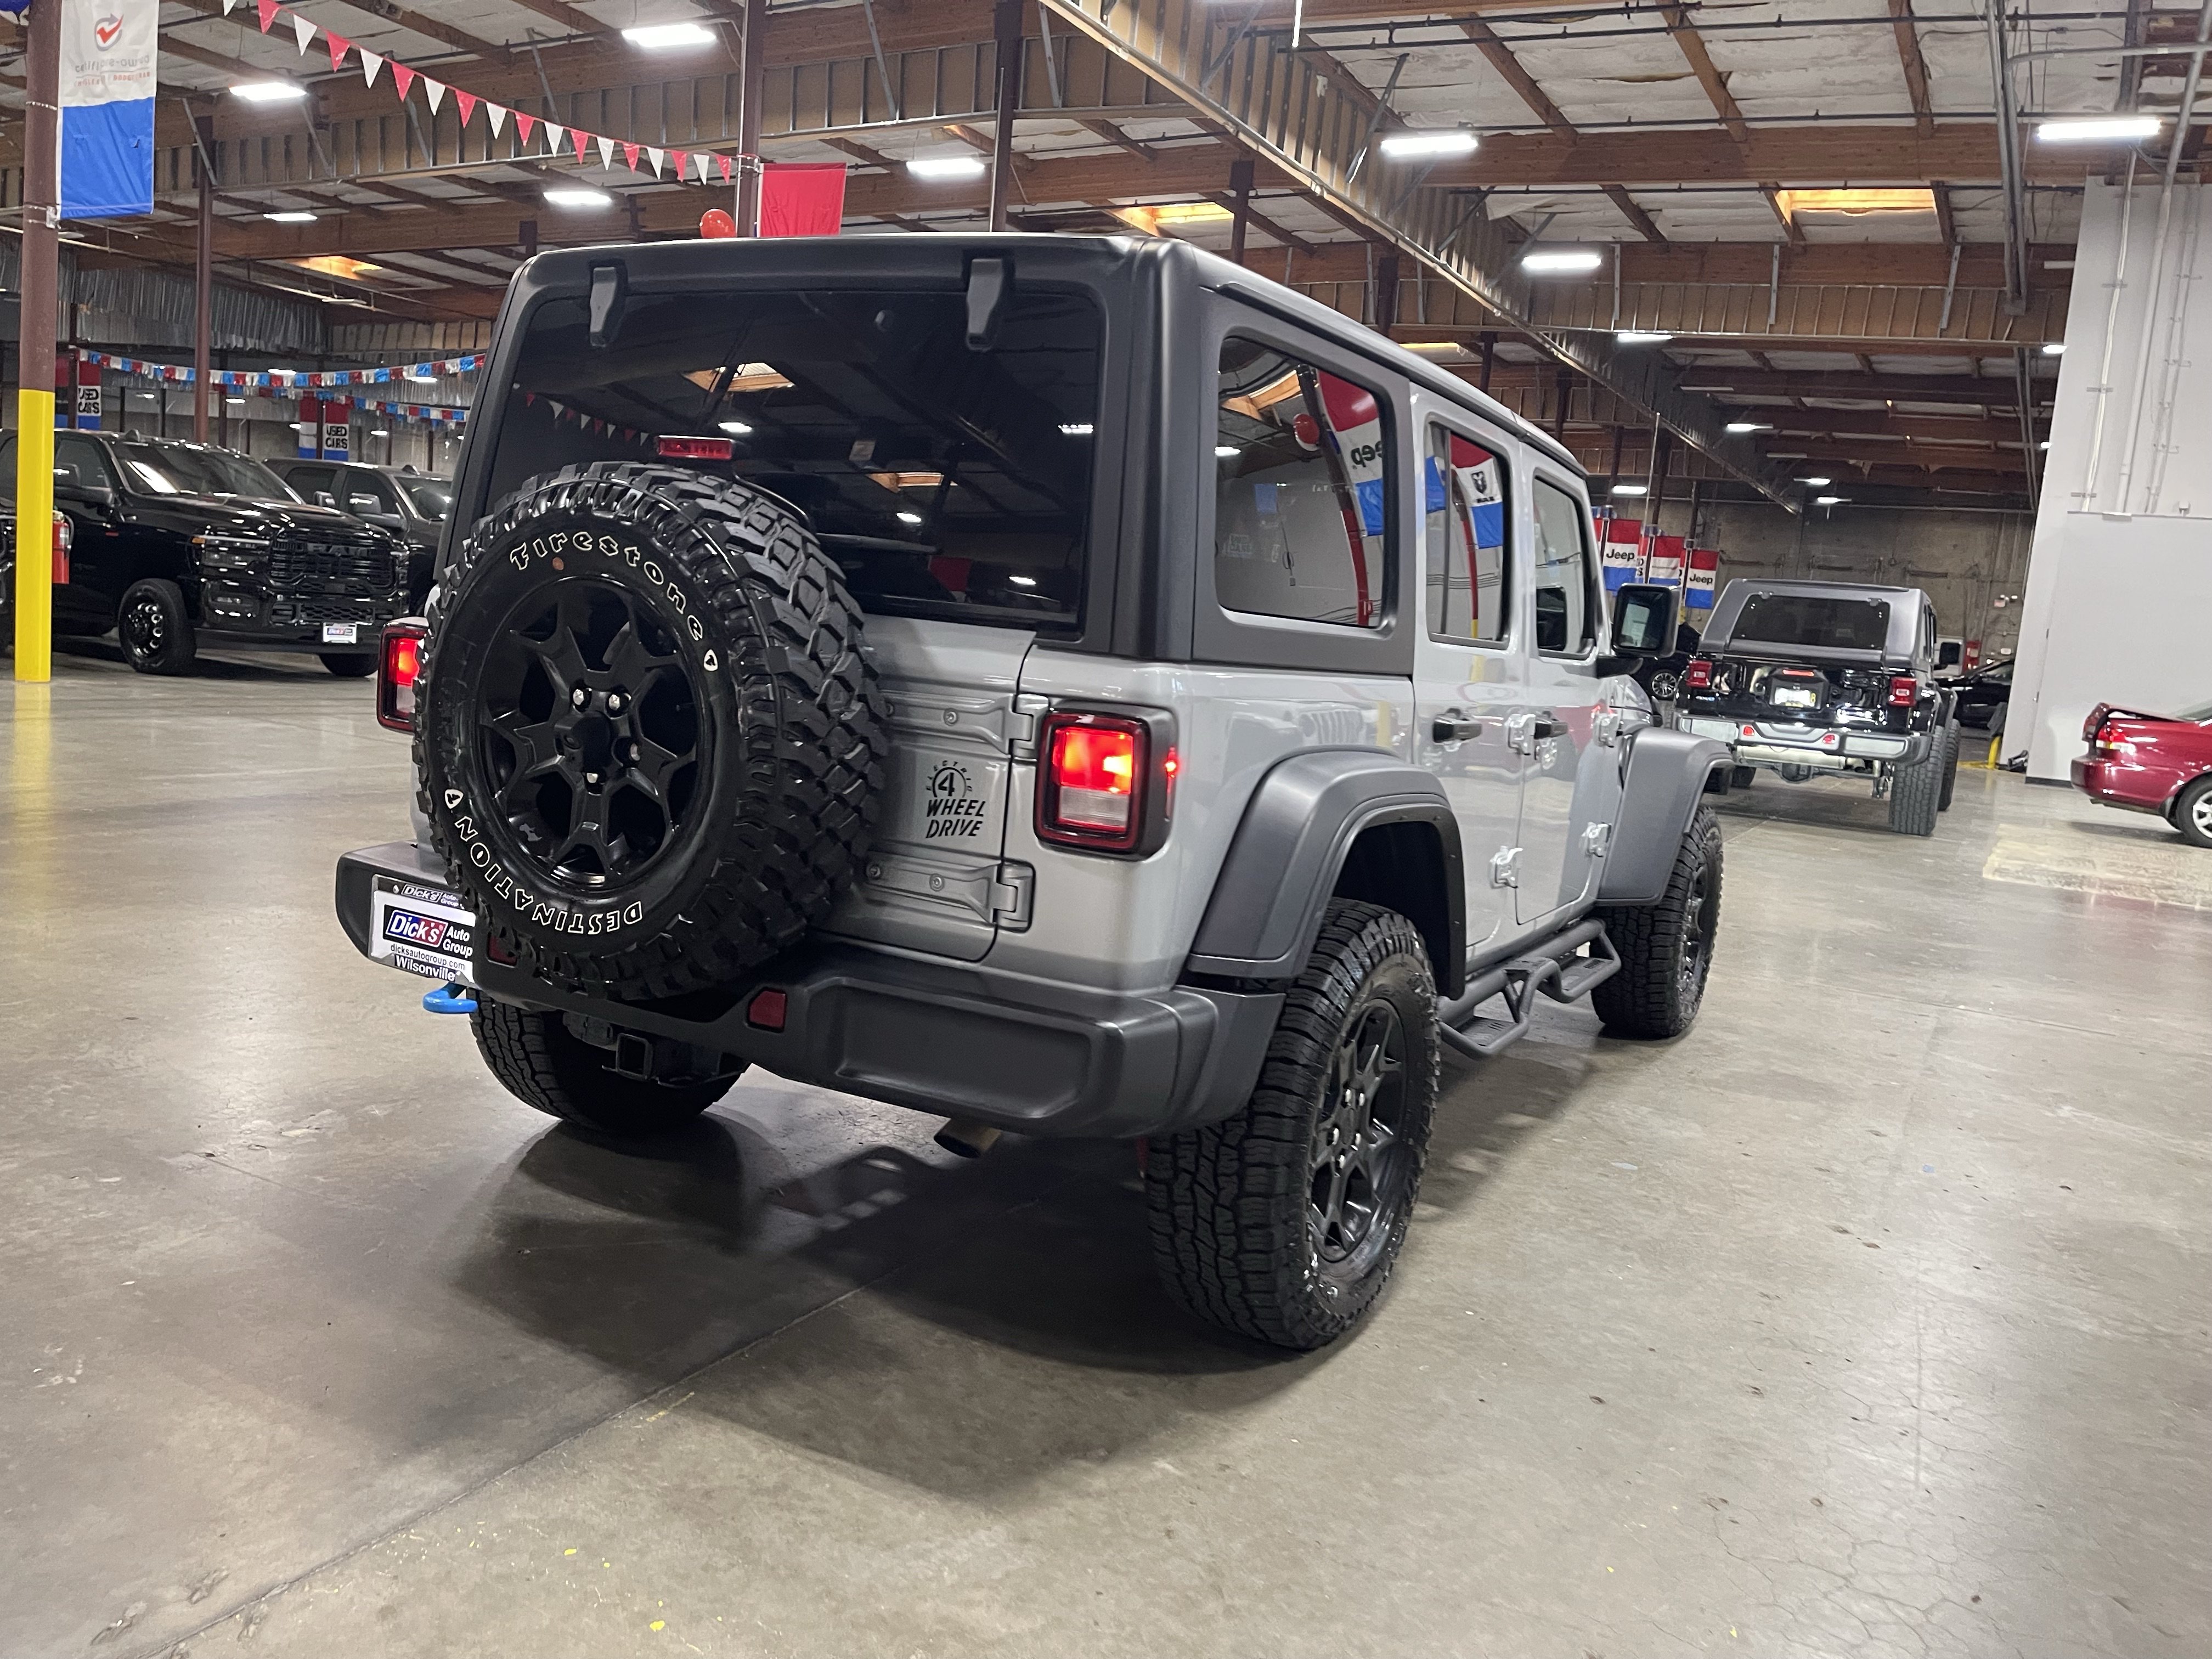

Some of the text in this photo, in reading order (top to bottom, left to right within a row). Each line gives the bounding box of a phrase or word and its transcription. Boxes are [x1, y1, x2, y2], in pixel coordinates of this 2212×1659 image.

[78, 388, 99, 400] UED
[1606, 549, 1635, 562] Jeep
[509, 531, 703, 641] Firestone
[1689, 574, 1713, 585] Jeep
[938, 772, 955, 797] 4
[926, 798, 986, 817] WHEEL
[925, 819, 984, 839] DRIVE
[454, 816, 642, 935] DESTINATION
[404, 886, 440, 901] Dick's
[390, 914, 470, 943] Dick's Auto
[390, 943, 465, 971] dicksautogroup.com
[442, 939, 473, 958] Group
[395, 954, 456, 981] Wilsonville
